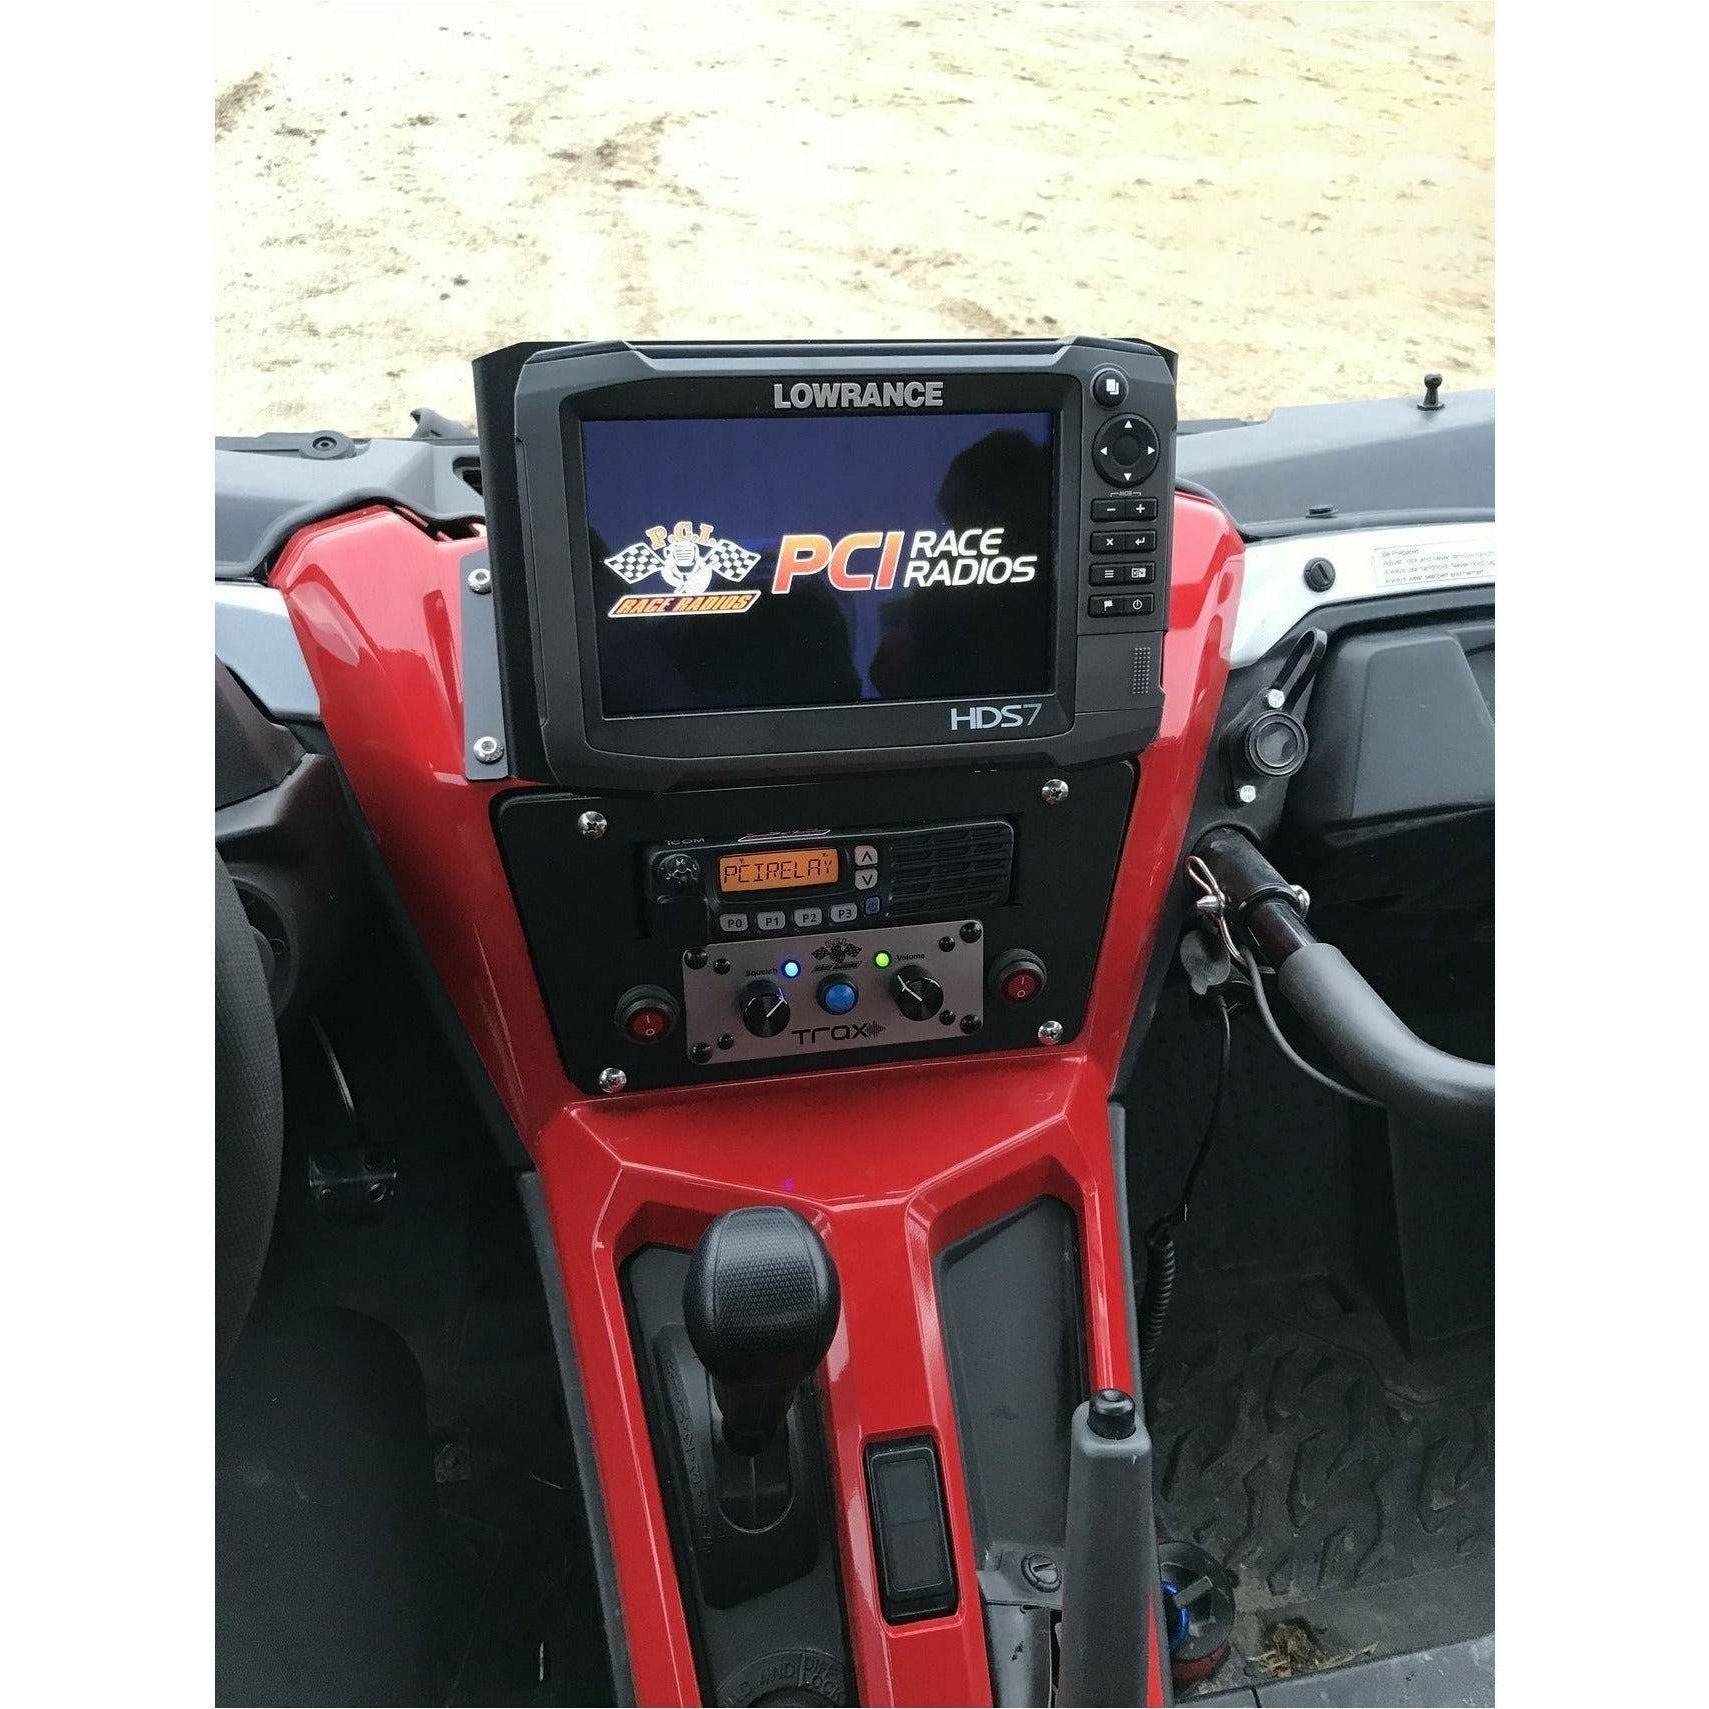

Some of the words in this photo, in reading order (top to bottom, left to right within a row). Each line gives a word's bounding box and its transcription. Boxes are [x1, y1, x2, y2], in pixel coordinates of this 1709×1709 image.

[774, 382, 943, 409] LOWRANCE
[910, 528, 1004, 558] RACE
[771, 531, 905, 594] PCI
[903, 555, 1038, 588] RADIOS
[616, 597, 675, 614] RACE
[672, 594, 753, 612] RADIOS
[950, 703, 1043, 731] HDS7
[723, 858, 833, 884] PCIRELAY
[728, 919, 742, 929] P0
[765, 917, 779, 927] P1
[802, 913, 816, 923] P2
[838, 909, 852, 919] P3
[896, 952, 925, 961] Volume
[745, 967, 778, 977] Squelch
